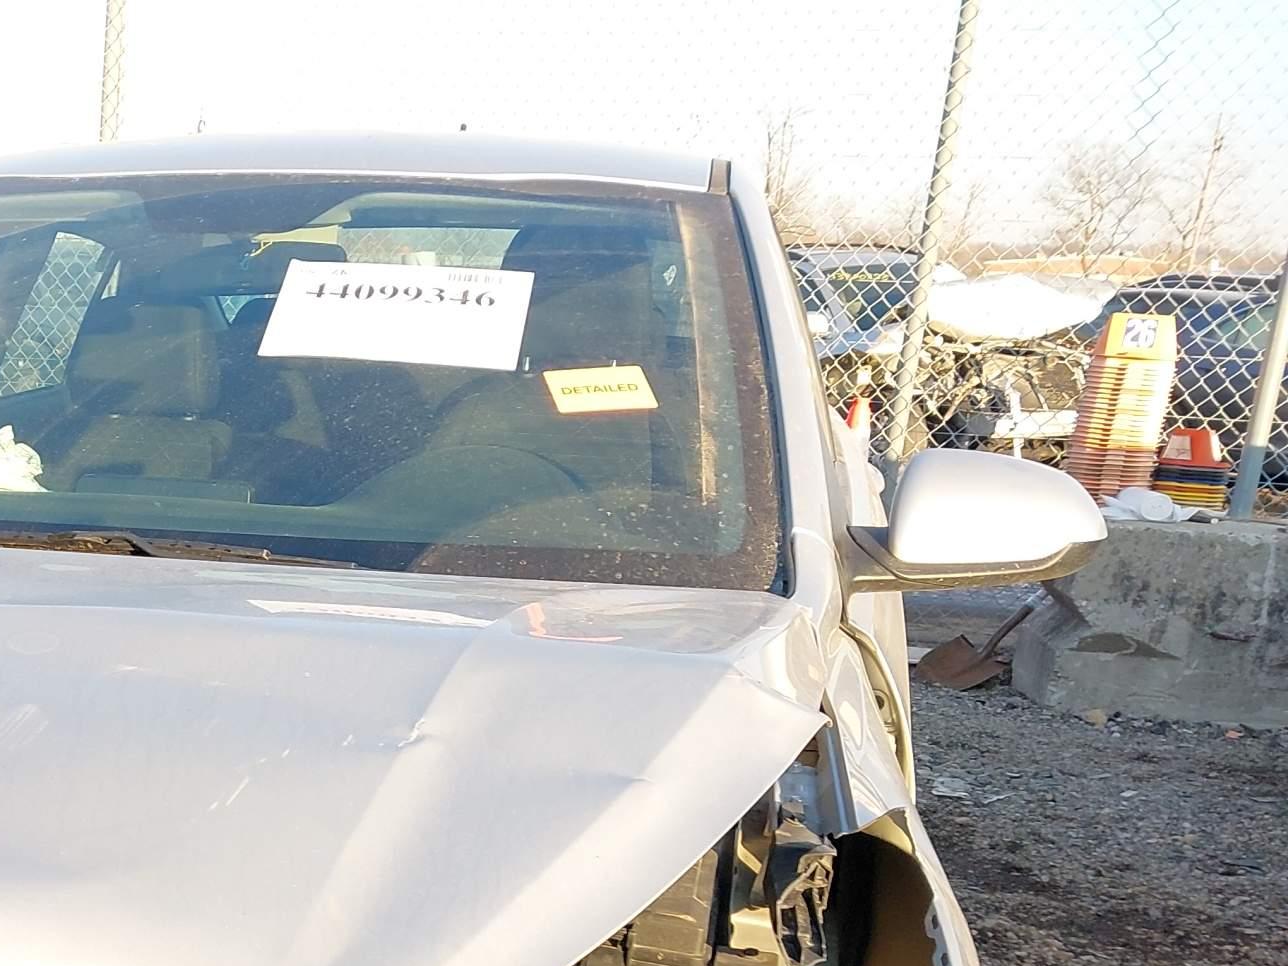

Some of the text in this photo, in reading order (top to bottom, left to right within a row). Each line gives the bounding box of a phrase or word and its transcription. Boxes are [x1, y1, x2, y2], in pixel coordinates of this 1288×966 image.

[306, 283, 495, 306] 44099346
[1123, 318, 1158, 348] 26
[560, 383, 639, 395] DETAILED
